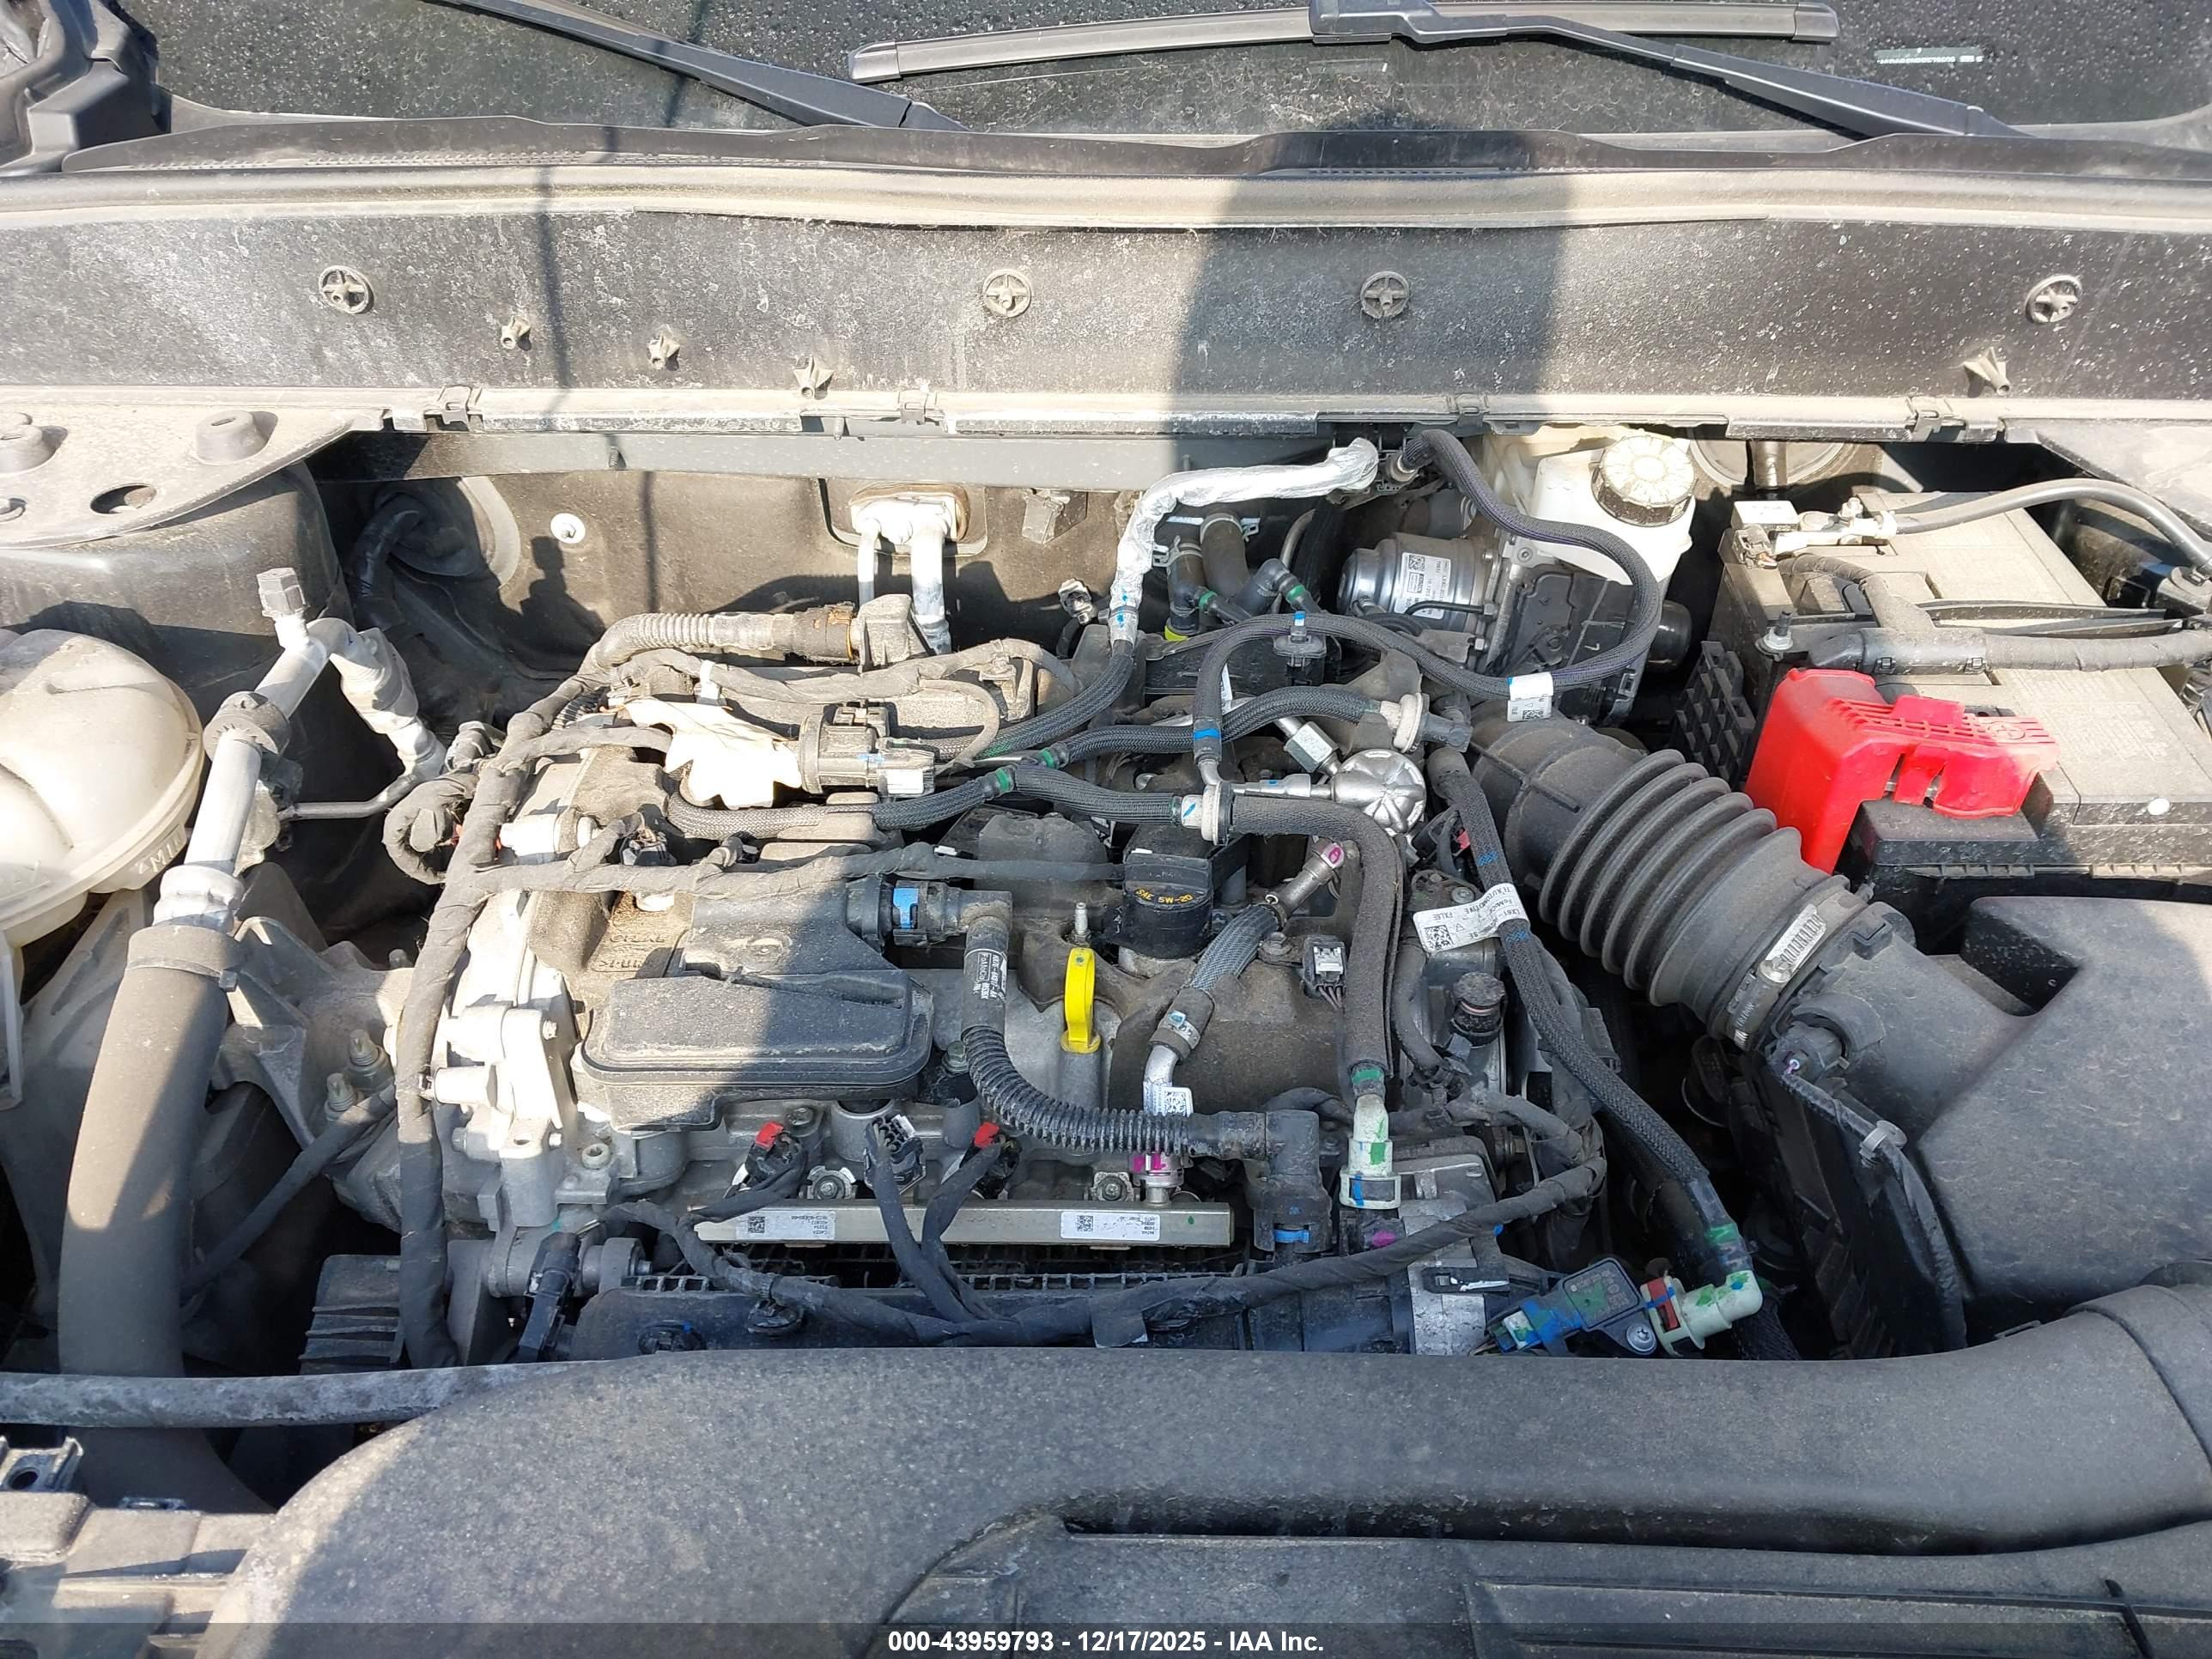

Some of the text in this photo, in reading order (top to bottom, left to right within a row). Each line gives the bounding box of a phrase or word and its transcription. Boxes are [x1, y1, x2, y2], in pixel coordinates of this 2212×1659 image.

[1135, 889, 1194, 904] SAE 5W-20
[978, 953, 988, 980] FoMoCo
